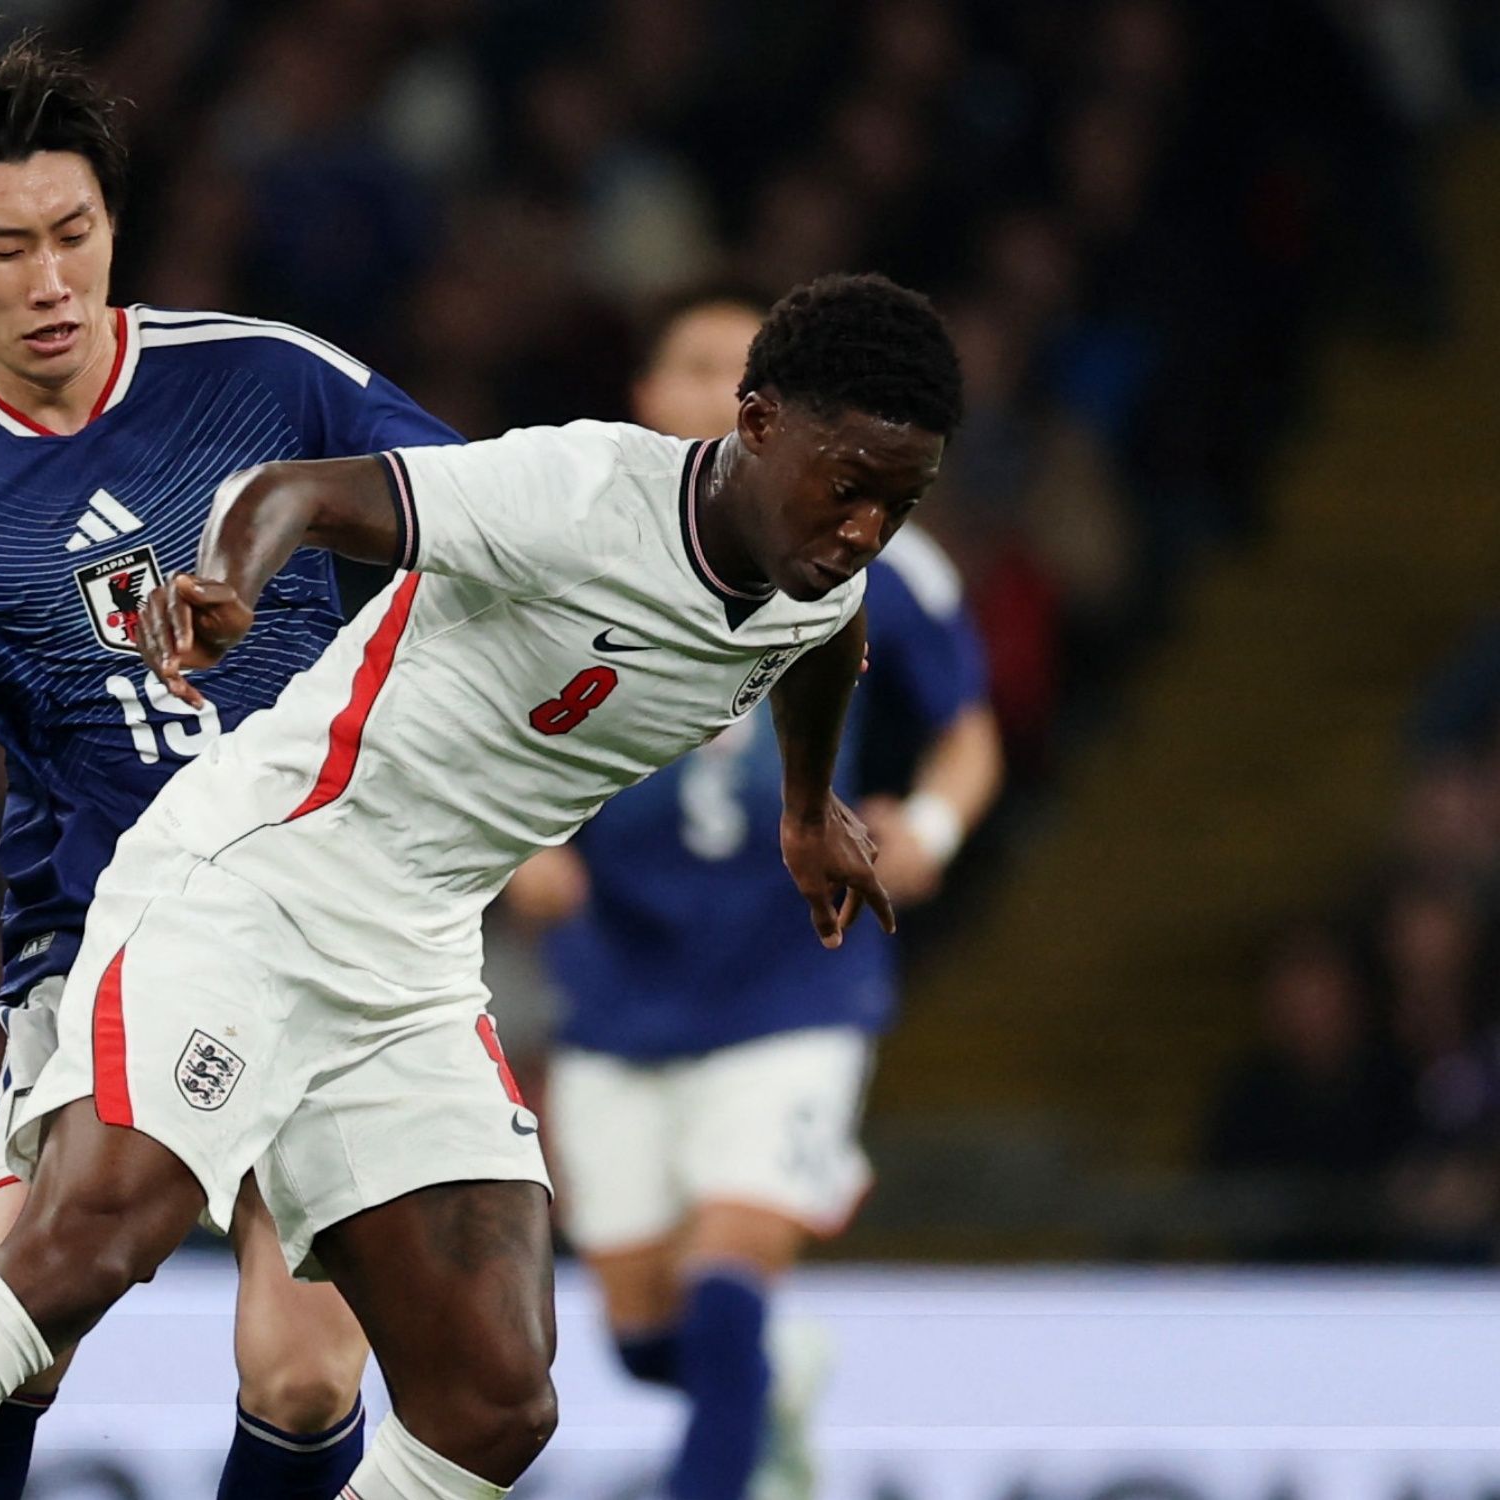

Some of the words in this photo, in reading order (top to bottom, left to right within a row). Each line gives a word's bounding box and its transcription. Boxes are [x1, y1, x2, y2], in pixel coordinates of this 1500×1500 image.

[95, 555, 135, 576] JAPAN
[105, 671, 222, 764] 19
[529, 665, 618, 735] 8
